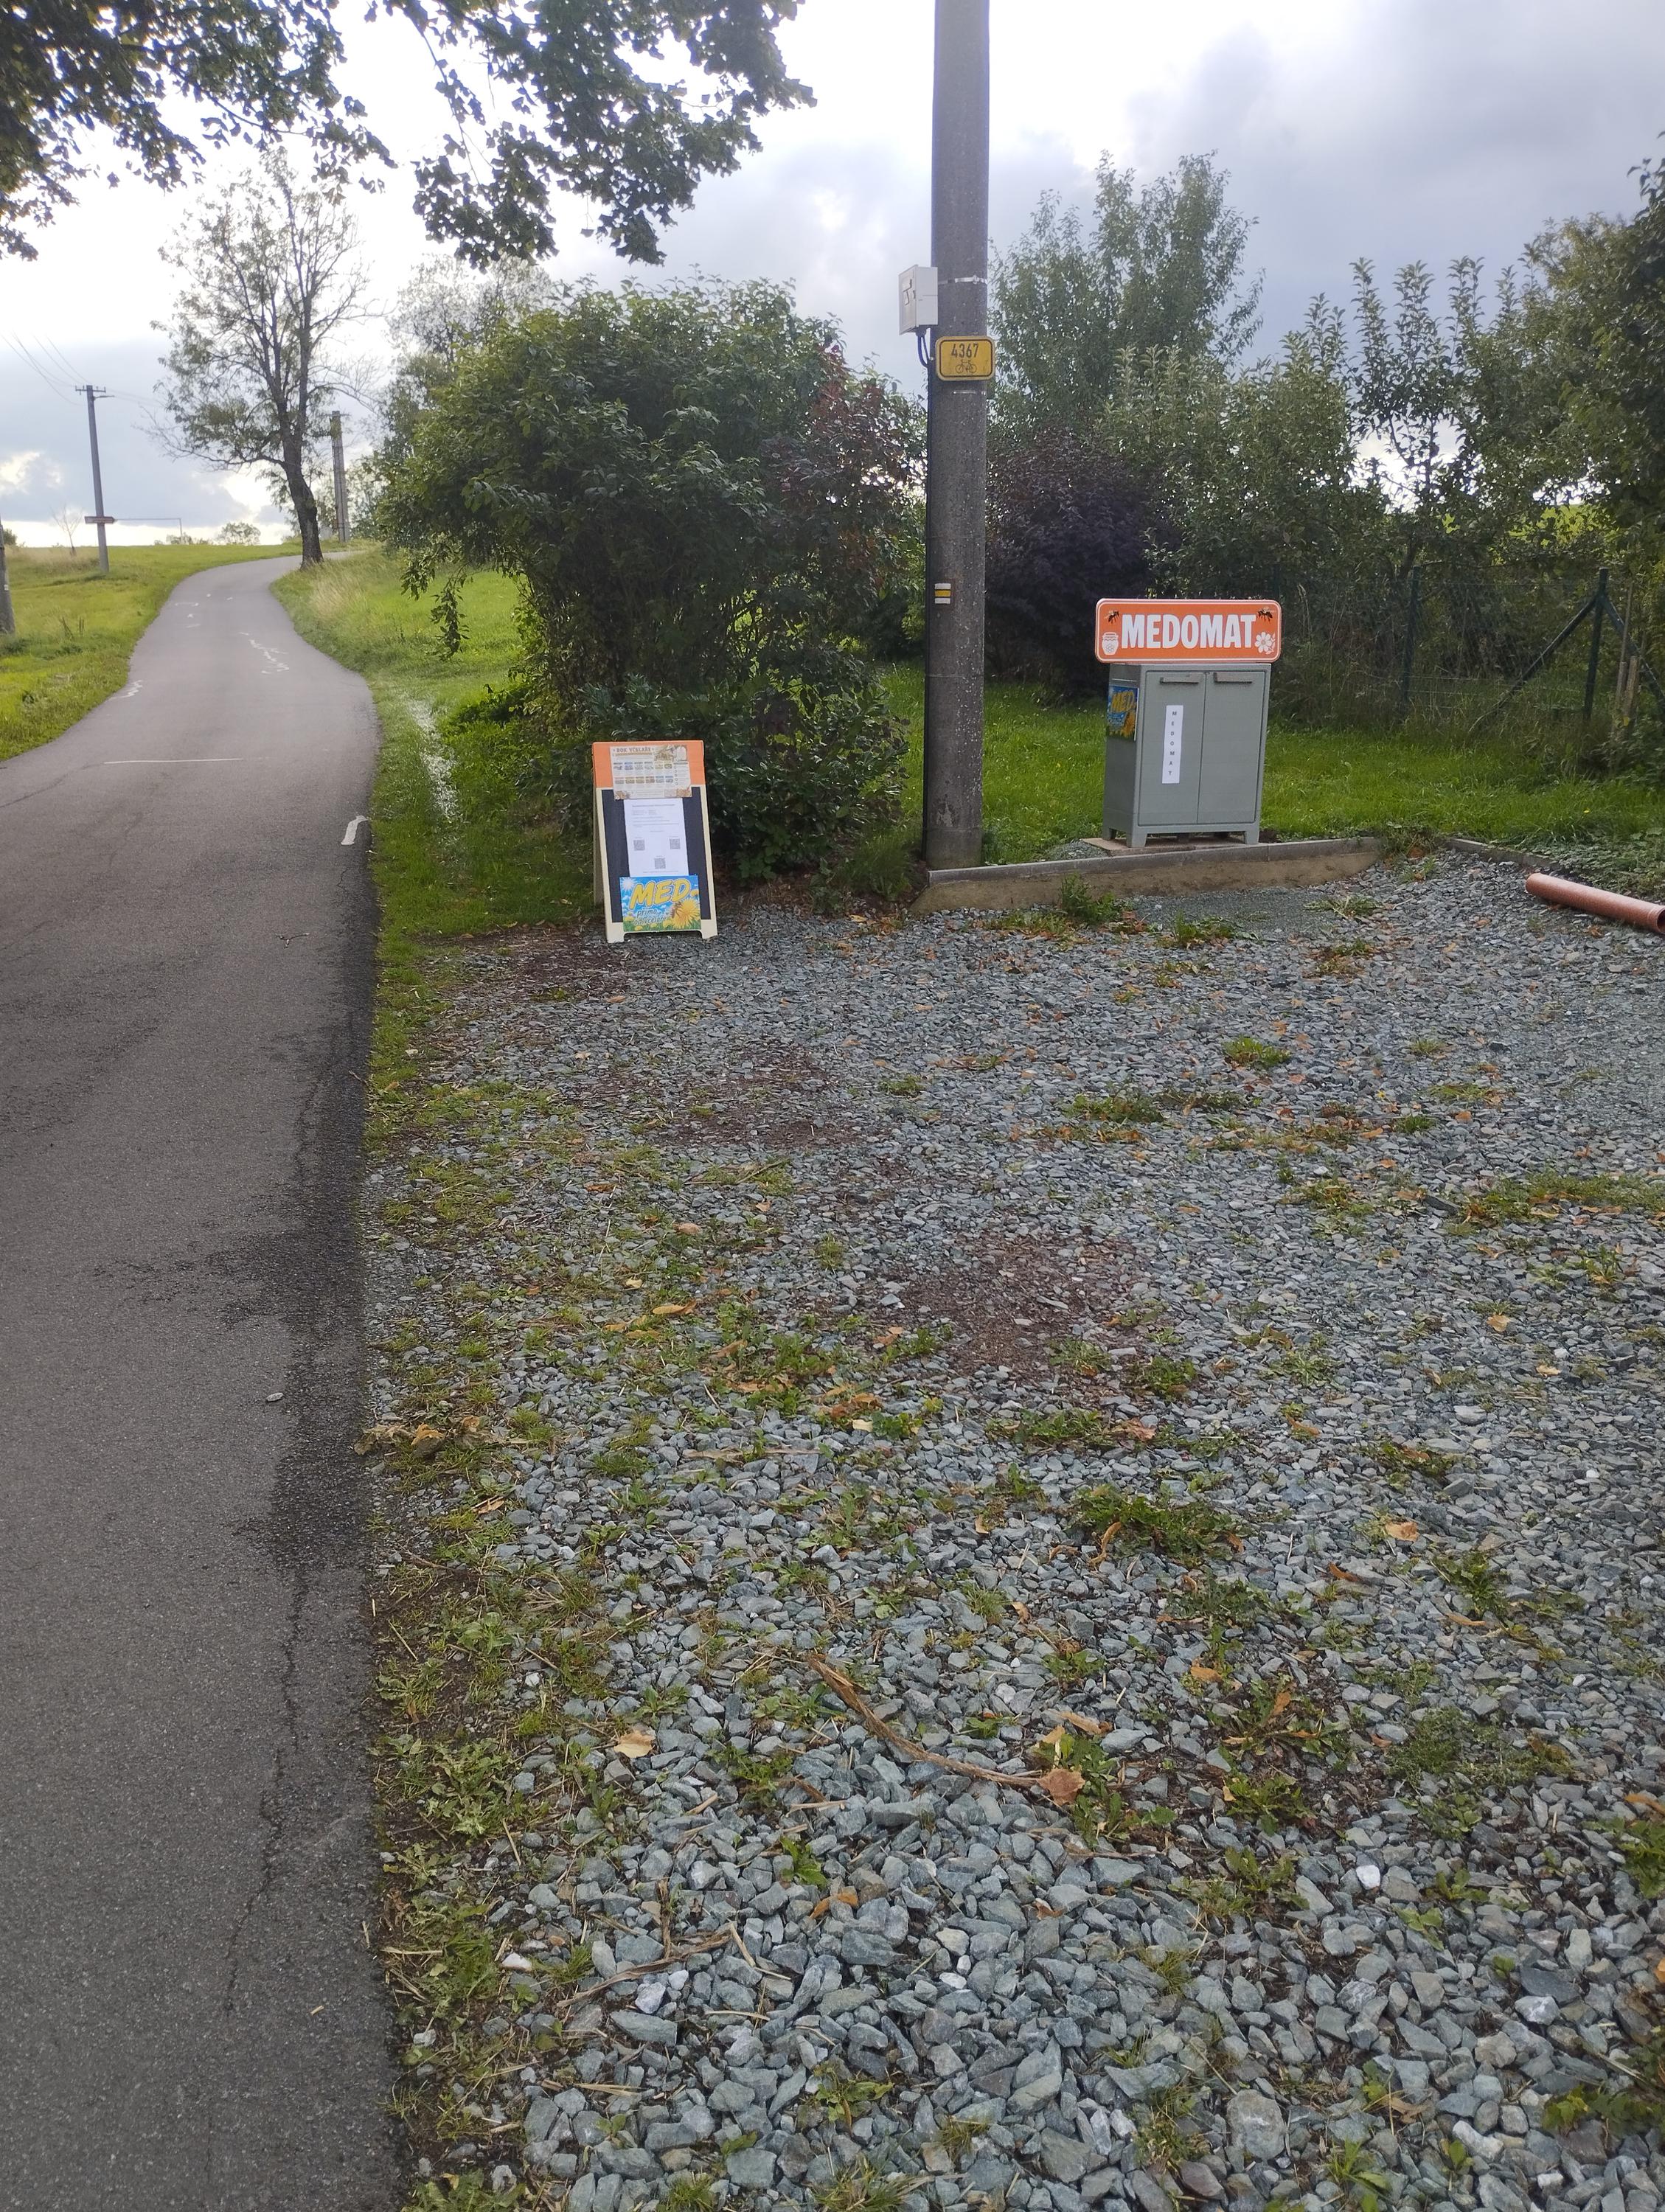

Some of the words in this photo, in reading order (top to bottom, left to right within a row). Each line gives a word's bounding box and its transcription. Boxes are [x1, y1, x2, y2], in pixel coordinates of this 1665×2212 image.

[951, 343, 979, 358] 4367
[1121, 614, 1256, 649] MEDOMAT
[1168, 711, 1178, 776] MEDOMAT
[629, 878, 690, 910] MED
